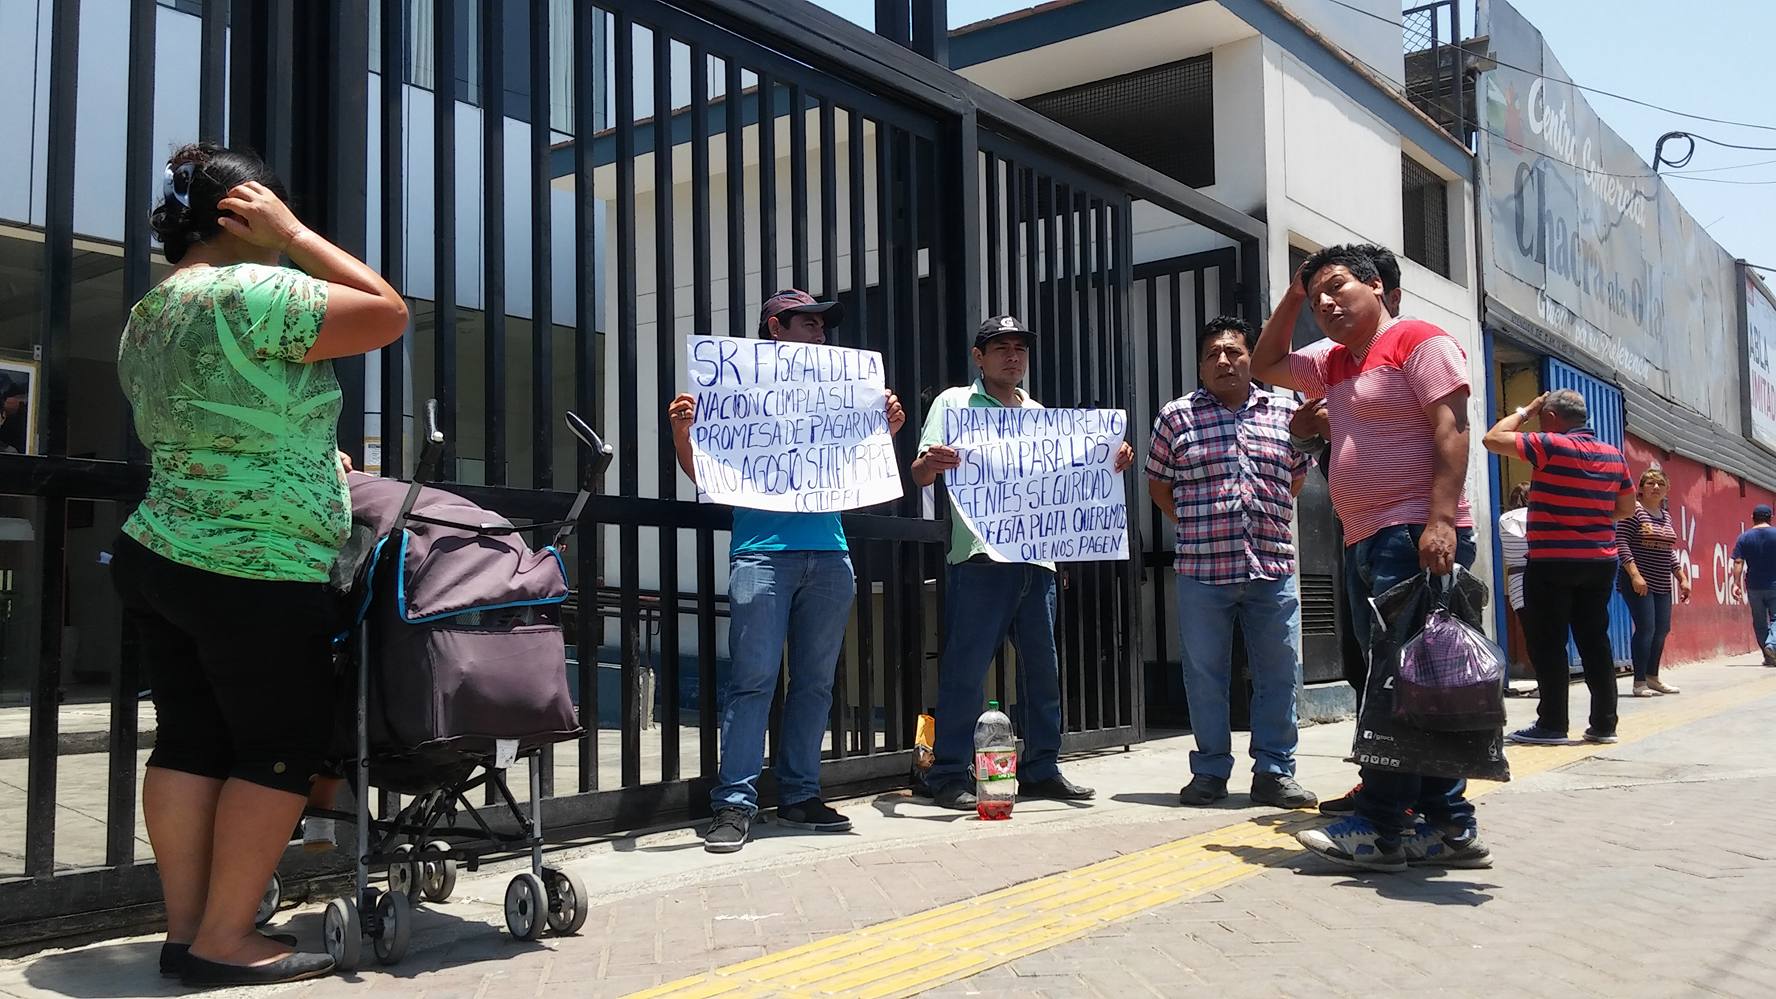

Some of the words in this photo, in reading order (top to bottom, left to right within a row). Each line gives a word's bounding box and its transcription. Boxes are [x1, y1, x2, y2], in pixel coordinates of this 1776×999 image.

[693, 339, 743, 388] SR
[858, 350, 878, 381] LA
[763, 386, 827, 418] CUMPLA
[829, 384, 855, 412] SU
[696, 421, 782, 452] PROMESA
[784, 418, 805, 446] DE
[742, 447, 802, 495] AGOSTO
[1018, 438, 1066, 478] PARA
[1070, 434, 1109, 468] LOS
[1029, 510, 1068, 541] PLATA
[1021, 541, 1047, 561] QUE
[1050, 538, 1075, 559] NOS
[1077, 532, 1123, 558] PAGEN
